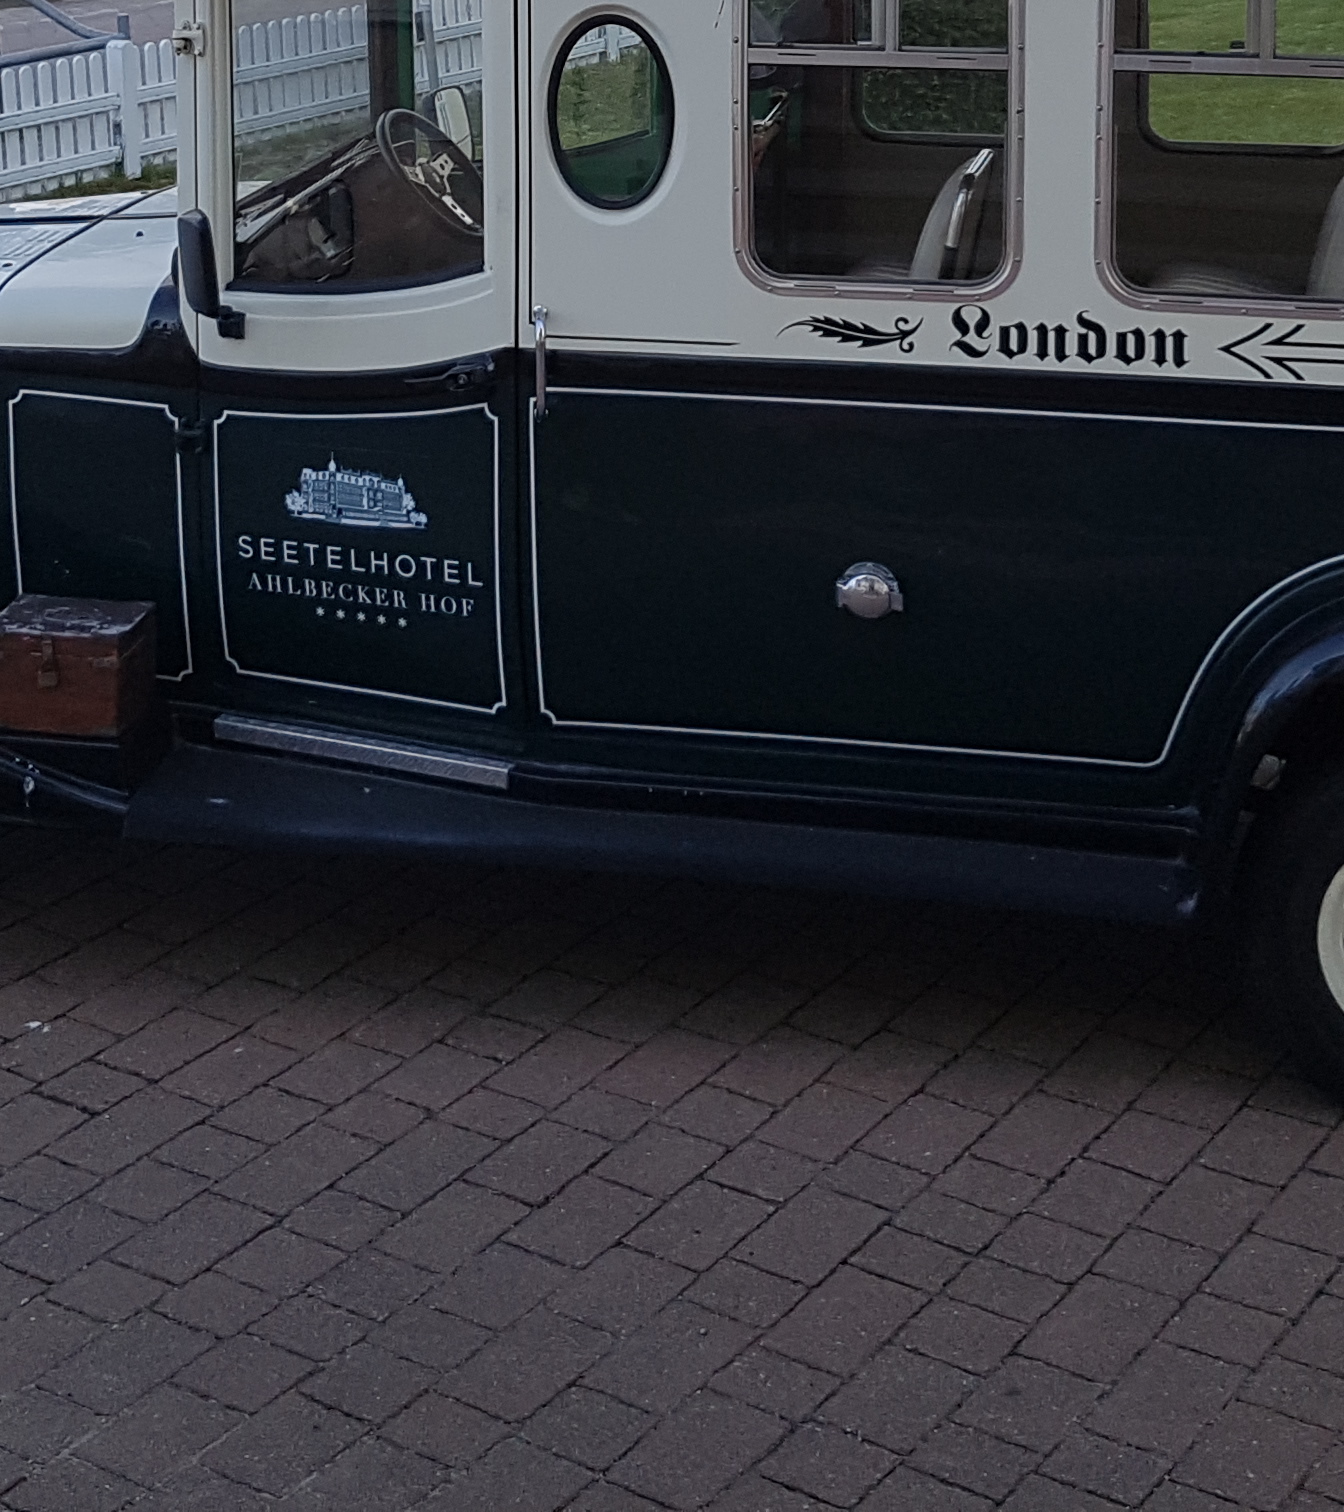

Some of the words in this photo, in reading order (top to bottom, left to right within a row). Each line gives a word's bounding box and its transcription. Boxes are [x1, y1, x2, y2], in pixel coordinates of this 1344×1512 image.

[948, 304, 1192, 369] London
[237, 534, 484, 587] SEETELHOTEL
[248, 571, 408, 609] AHLBECKER
[418, 592, 475, 617] HOF
